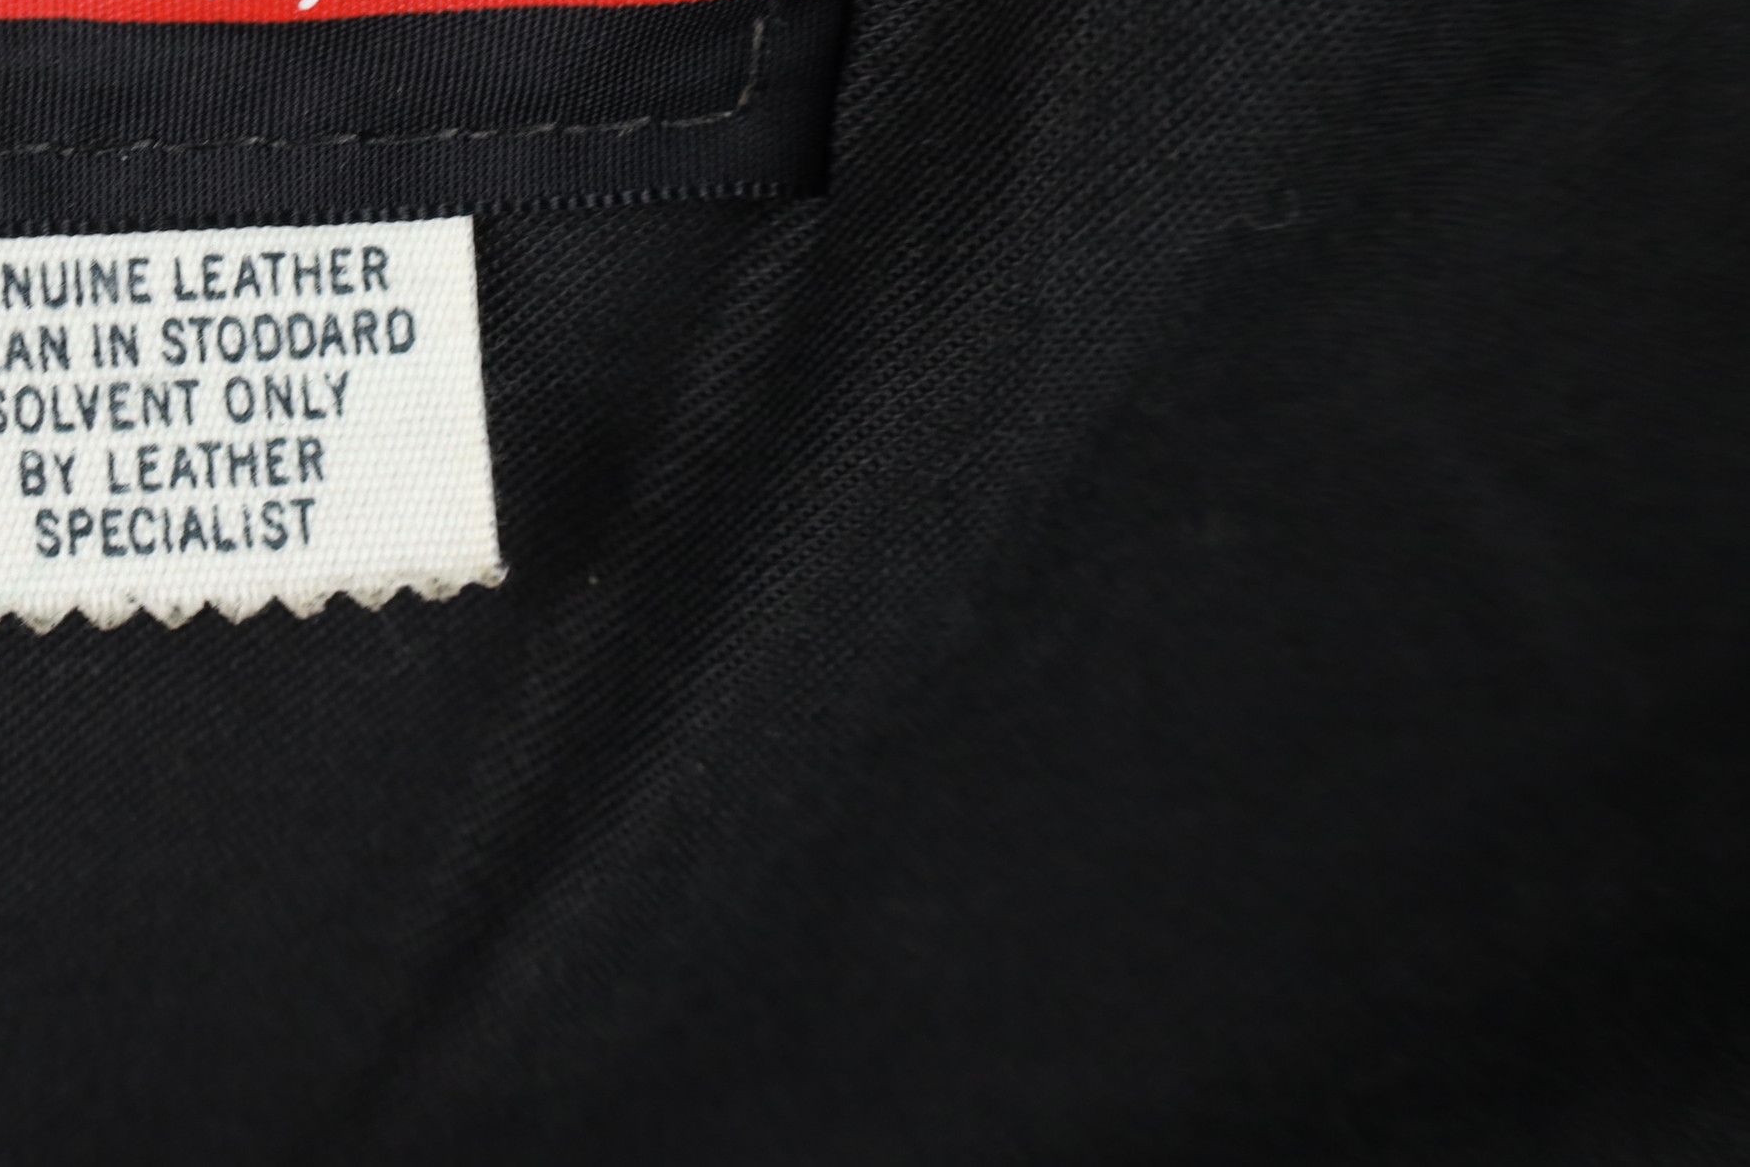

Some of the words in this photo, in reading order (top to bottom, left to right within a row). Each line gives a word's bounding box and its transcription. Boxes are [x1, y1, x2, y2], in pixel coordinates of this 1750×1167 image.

[172, 245, 389, 303] LEATHER
[91, 323, 140, 369] IN
[160, 306, 417, 367] STODDARD
[223, 370, 349, 425] ONLY
[18, 449, 76, 498] BY
[107, 436, 325, 495] LEATHER
[34, 497, 316, 559] SPECIALIST
